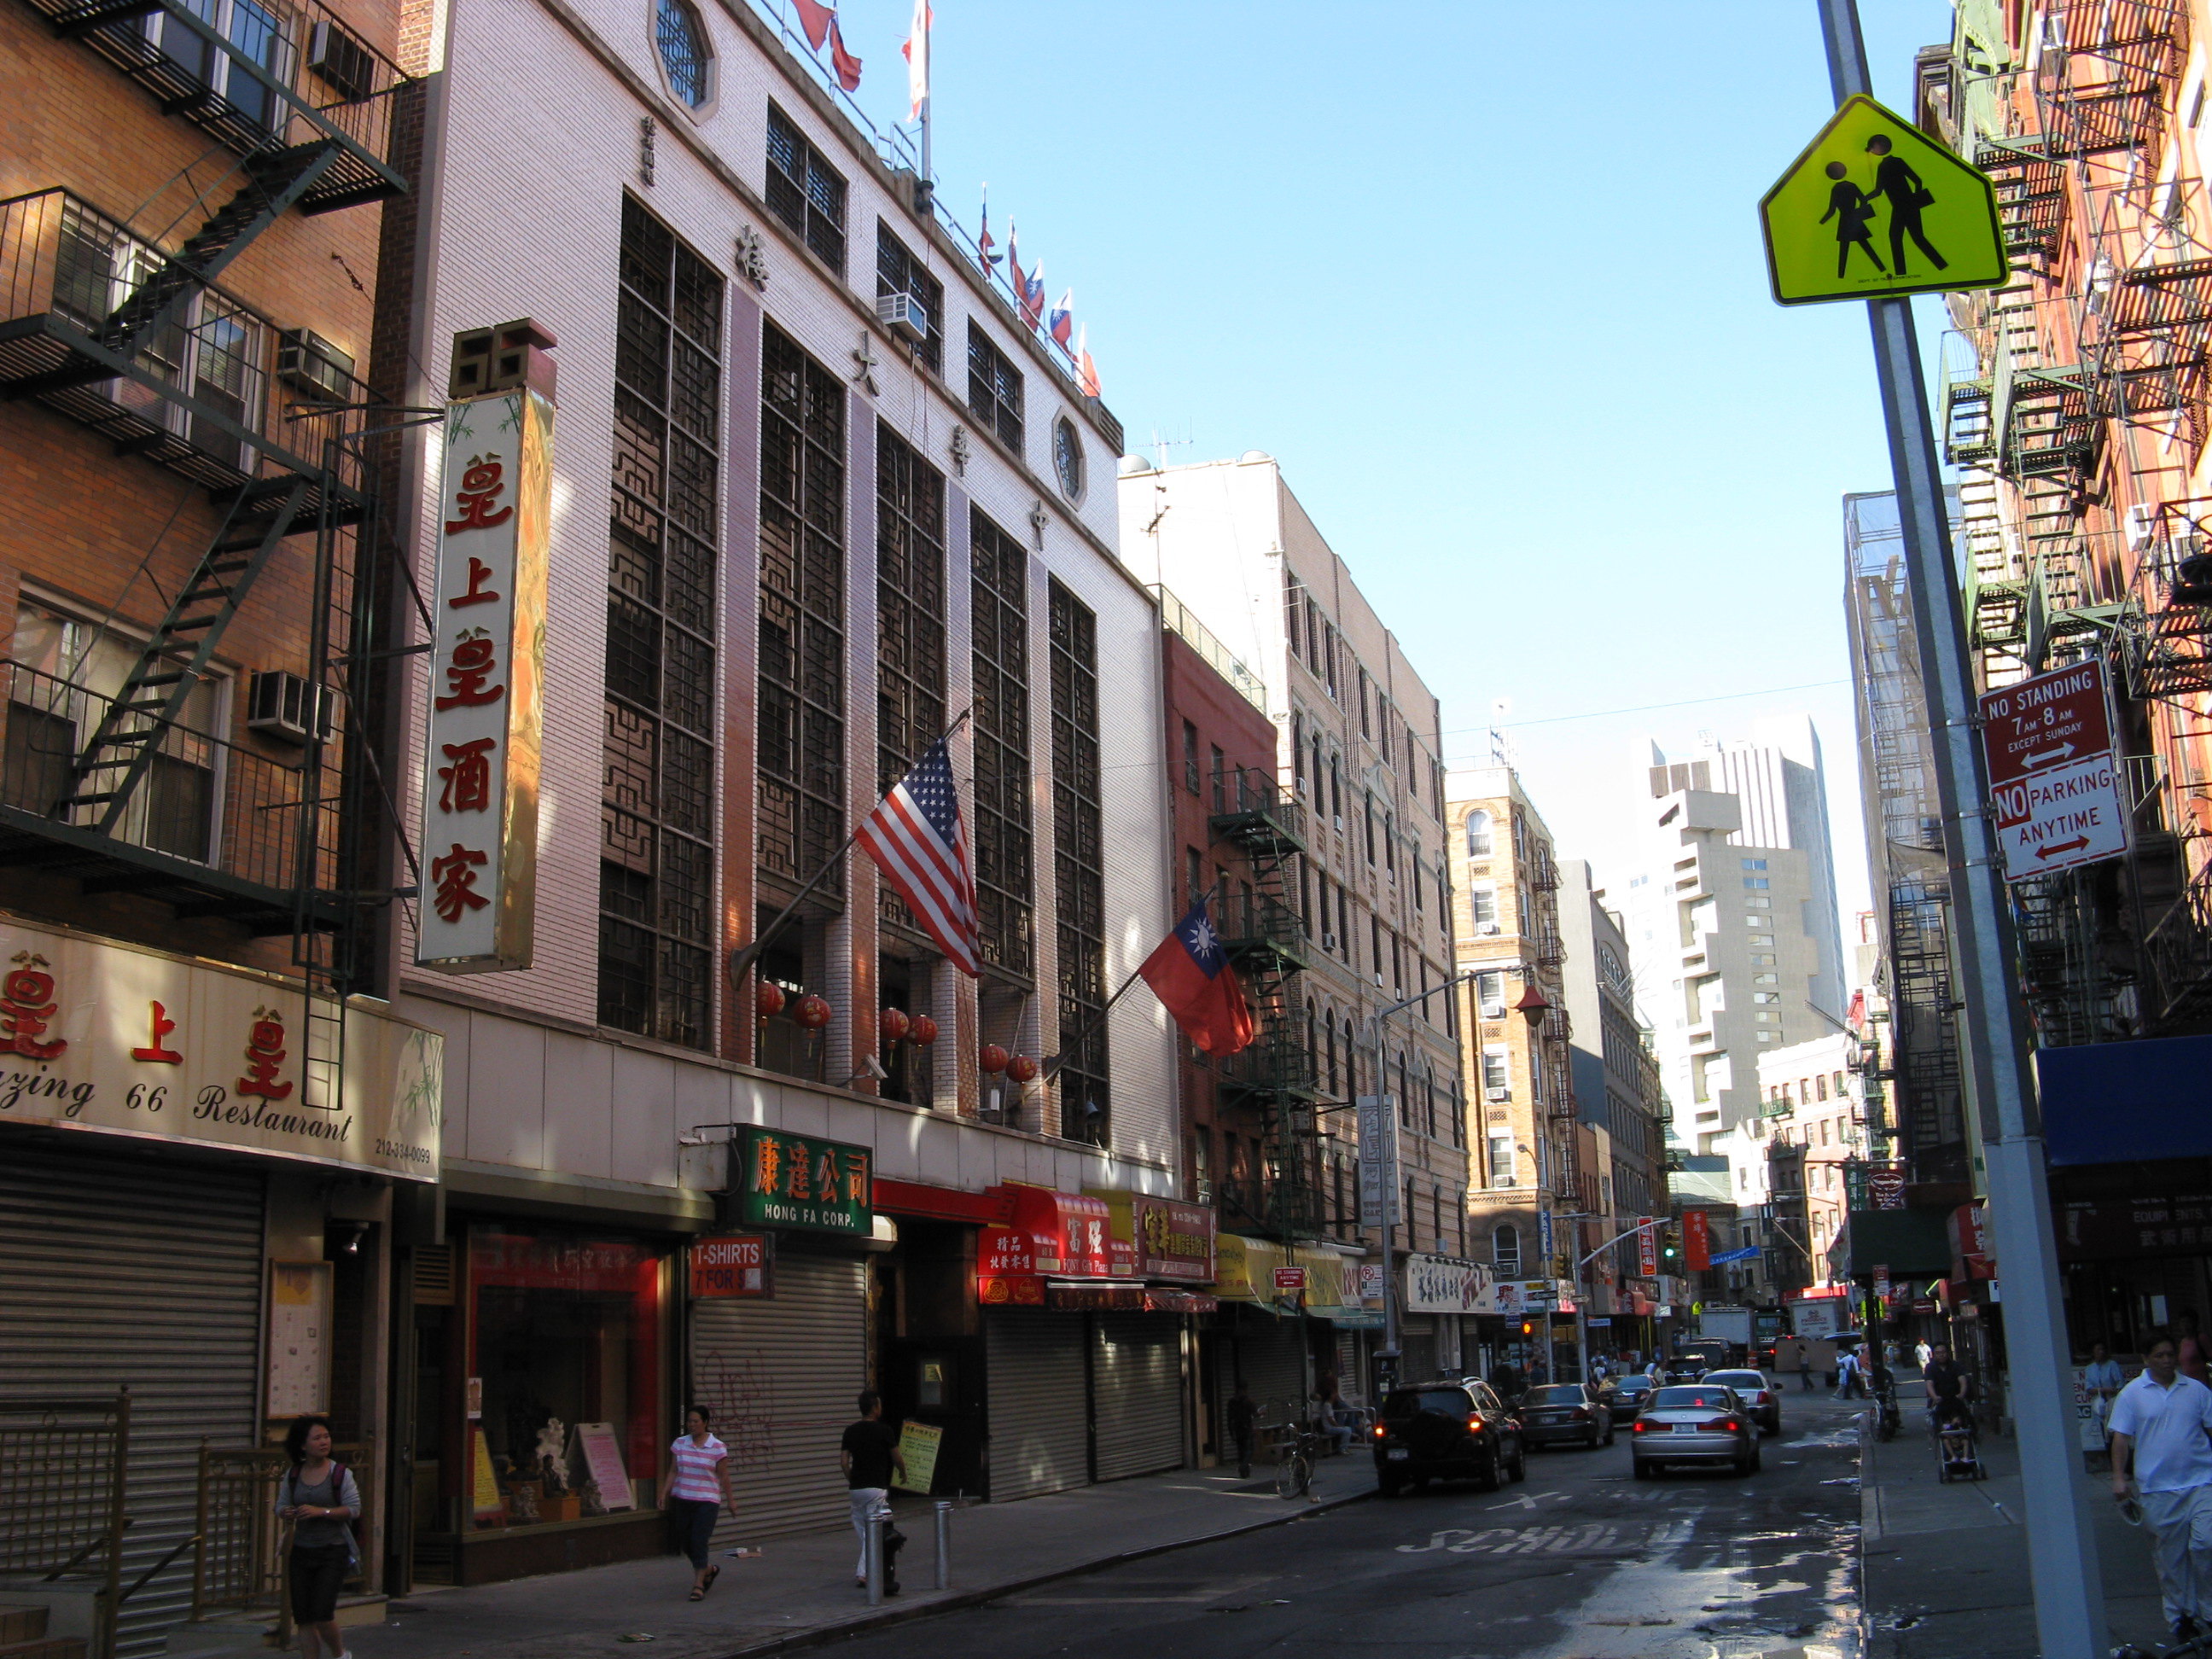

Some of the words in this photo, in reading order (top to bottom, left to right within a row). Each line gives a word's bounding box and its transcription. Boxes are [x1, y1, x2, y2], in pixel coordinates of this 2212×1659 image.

[429, 452, 515, 925] 皇上皇酒家
[1988, 700, 2009, 720] NO
[2017, 670, 2093, 711] STANDING
[2007, 734, 2041, 753] EXCEPT
[2045, 721, 2082, 741] SUNDAY
[1995, 784, 2029, 823] NO
[2030, 768, 2111, 808] PARKING
[2019, 806, 2102, 846] ANYTIME
[0, 1065, 96, 1118] zing
[125, 1083, 168, 1112] 66
[193, 1085, 353, 1142] Restaurant
[765, 1203, 797, 1221] HONG
[803, 1208, 817, 1224] FA
[823, 1210, 854, 1227] CORP.
[696, 1243, 760, 1265] T-SHIRTS
[707, 1268, 734, 1290] FOR
